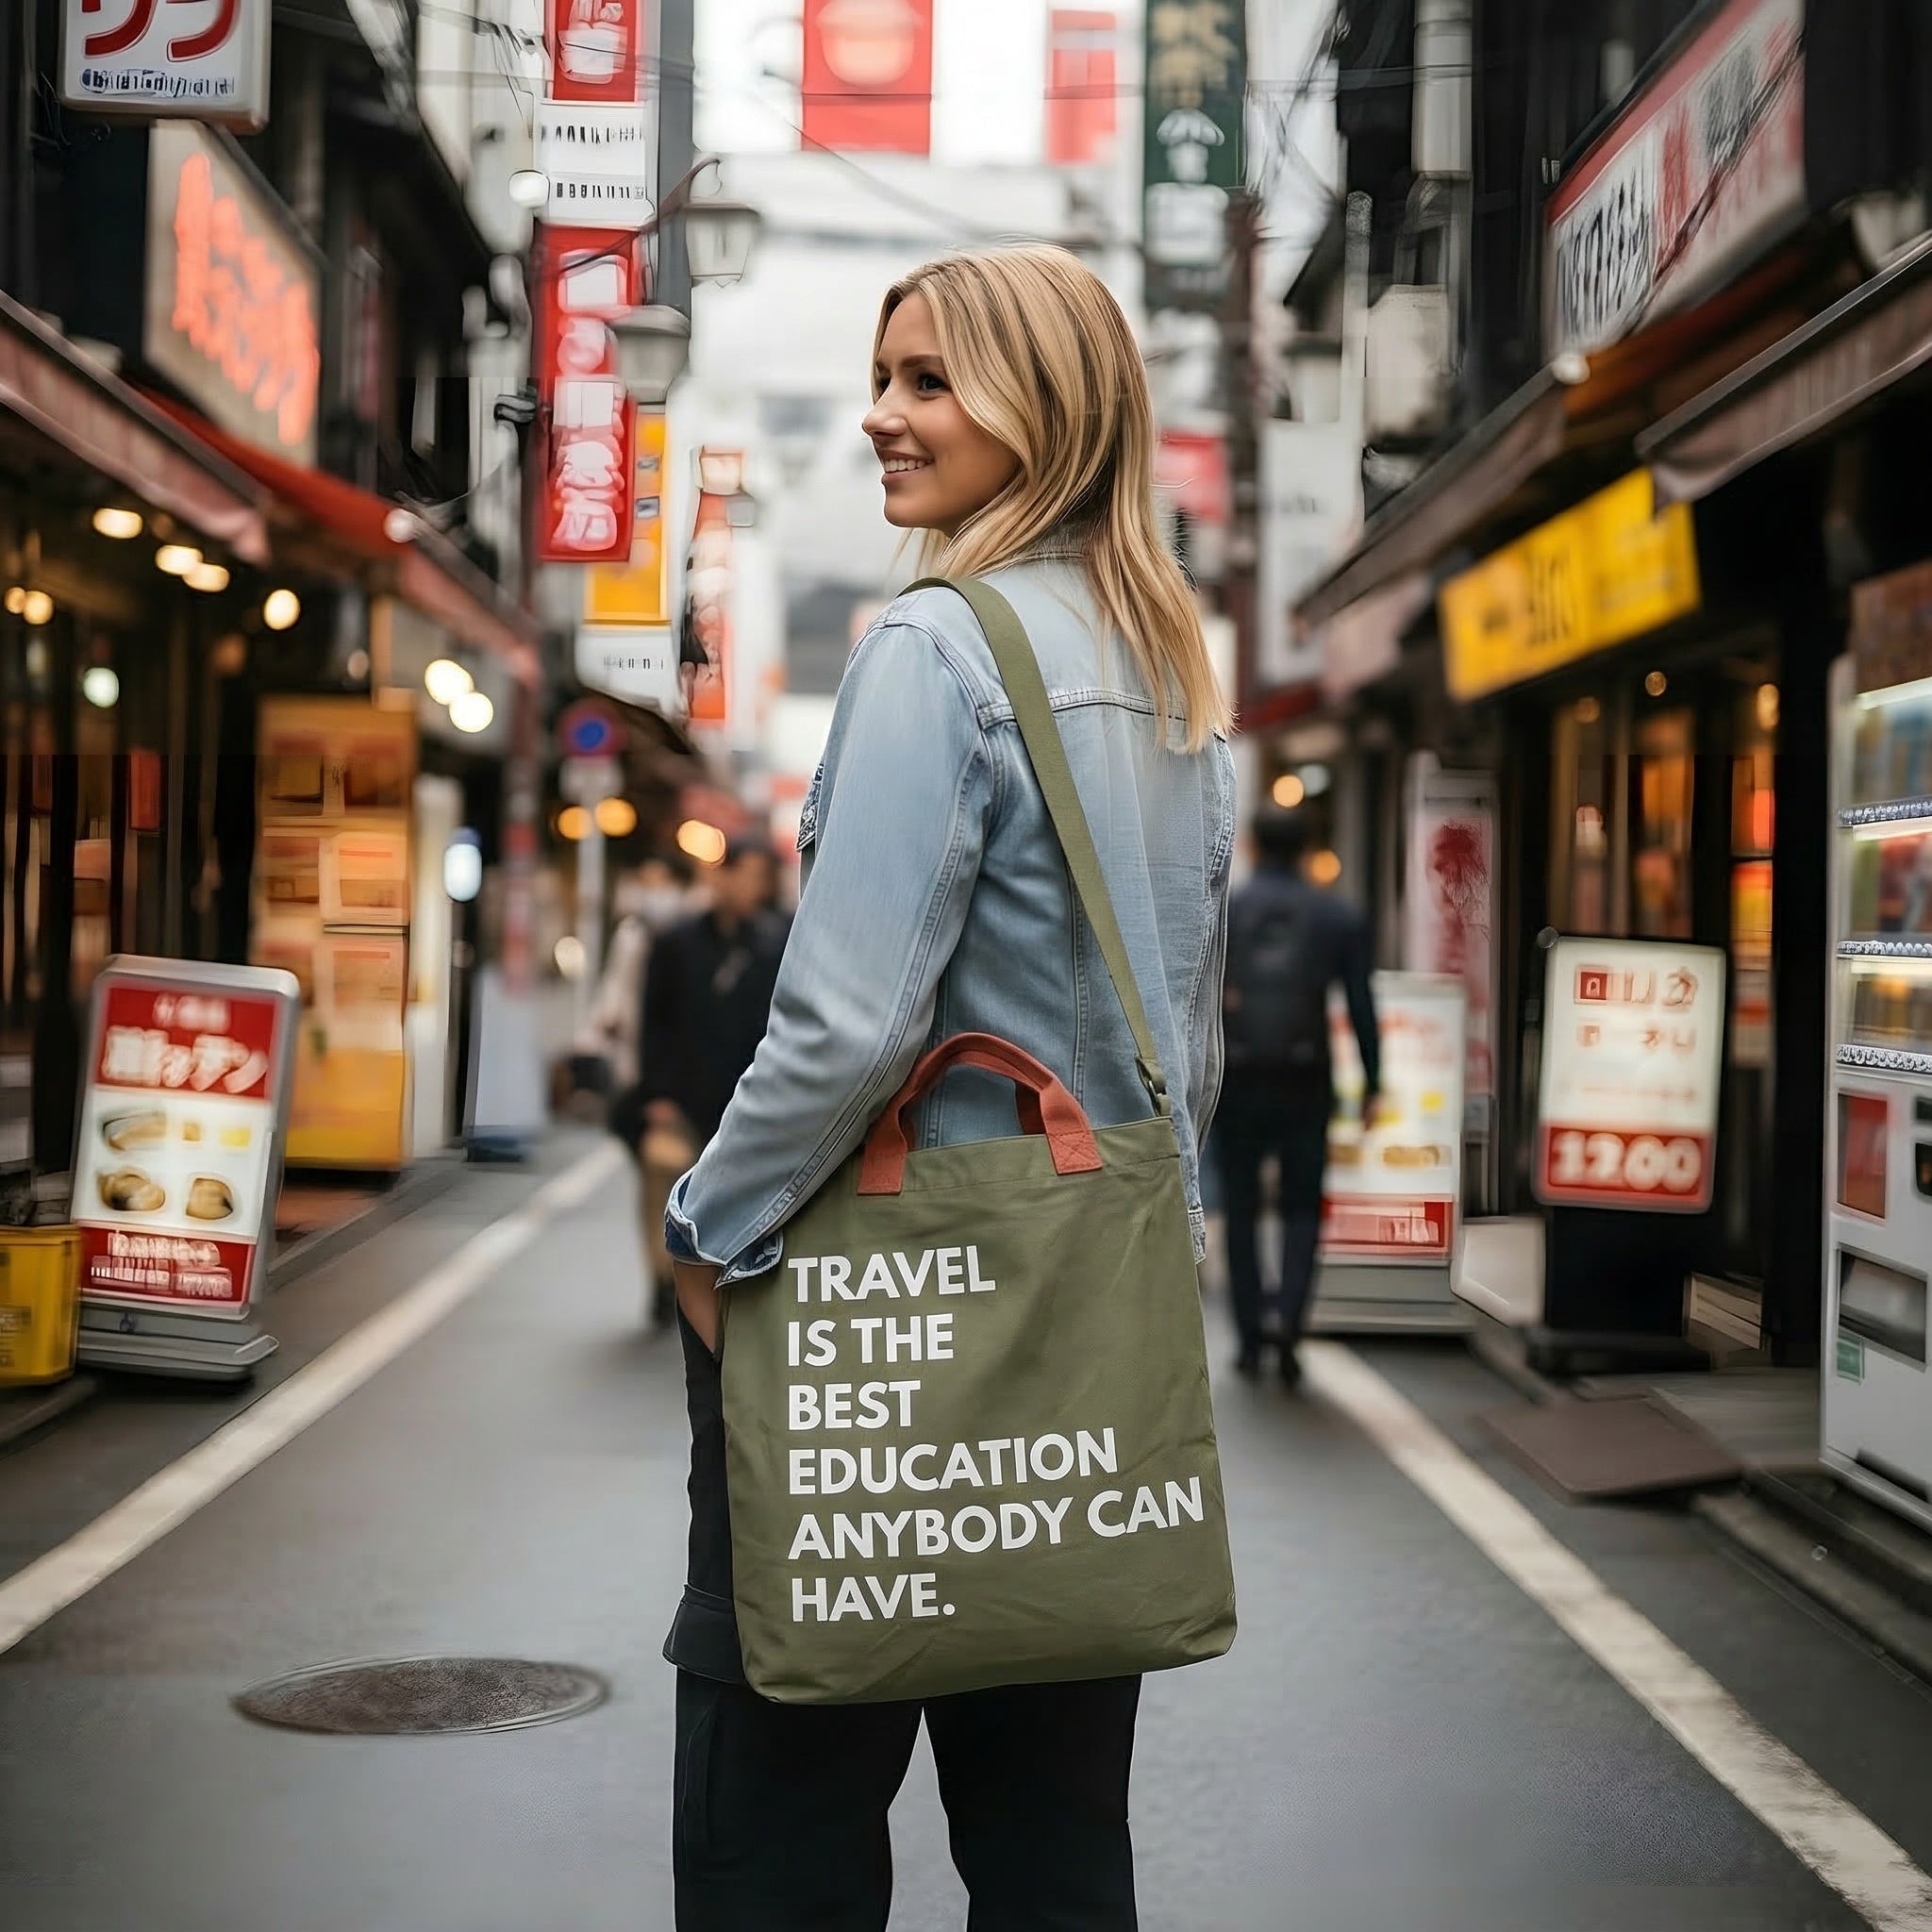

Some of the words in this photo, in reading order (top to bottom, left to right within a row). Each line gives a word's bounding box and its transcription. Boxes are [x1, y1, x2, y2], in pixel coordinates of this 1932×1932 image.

[787, 1244, 996, 1303] TRAVEL
[788, 1319, 837, 1367] IS
[850, 1312, 954, 1364] THE
[789, 1379, 922, 1431] BEST
[789, 1426, 1118, 1495] EDUCATION
[787, 1495, 1074, 1560] ANYBODY
[1087, 1475, 1204, 1539] CAN
[791, 1572, 956, 1623] HAVE.
